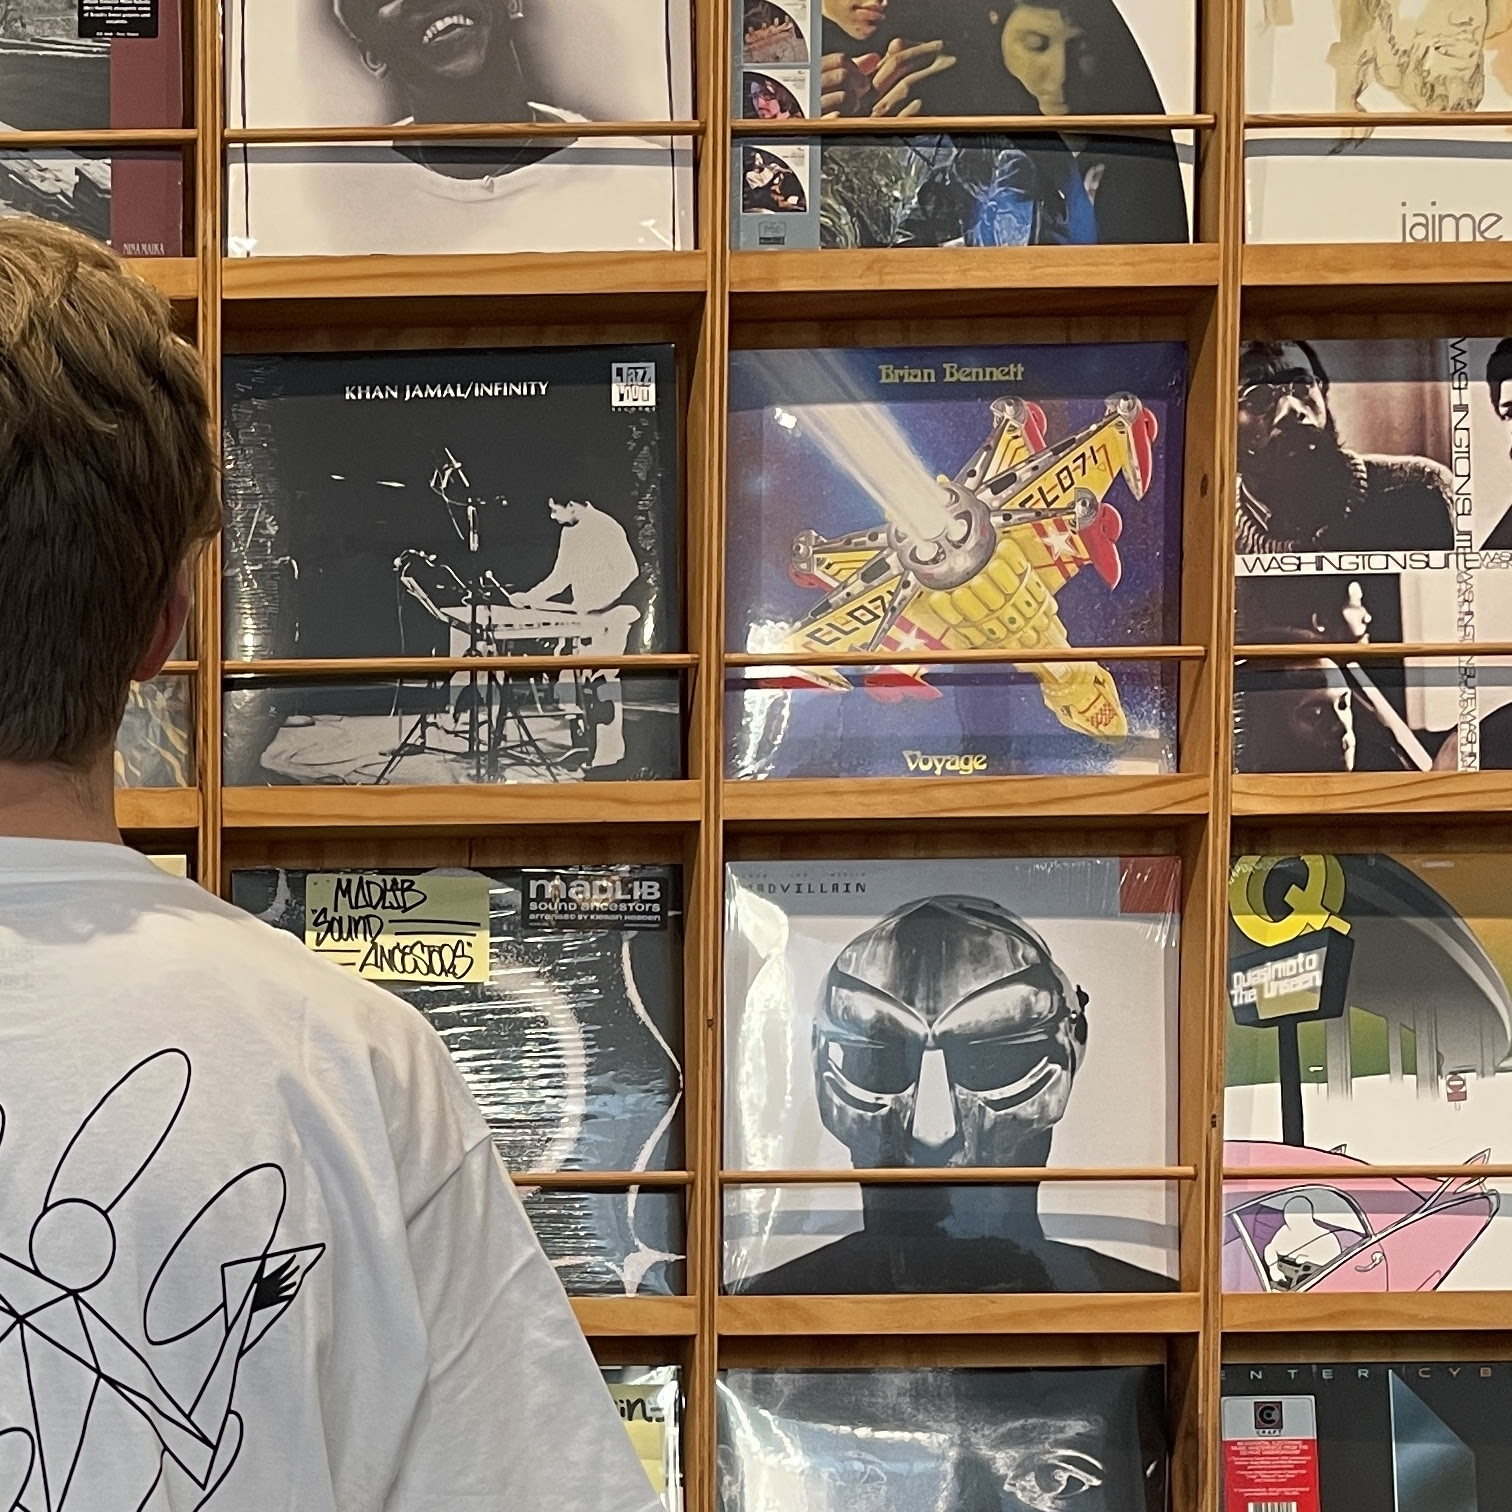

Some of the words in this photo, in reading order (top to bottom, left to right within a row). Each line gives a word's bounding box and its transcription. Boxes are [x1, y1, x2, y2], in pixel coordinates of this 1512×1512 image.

[878, 364, 936, 383] Brian
[943, 363, 1025, 383] Bennett
[345, 384, 398, 400] KHAN
[902, 750, 989, 776] Voyage
[1232, 953, 1318, 990] Quasimoto
[1230, 986, 1257, 1006] The
[1263, 970, 1322, 998] Unseen
